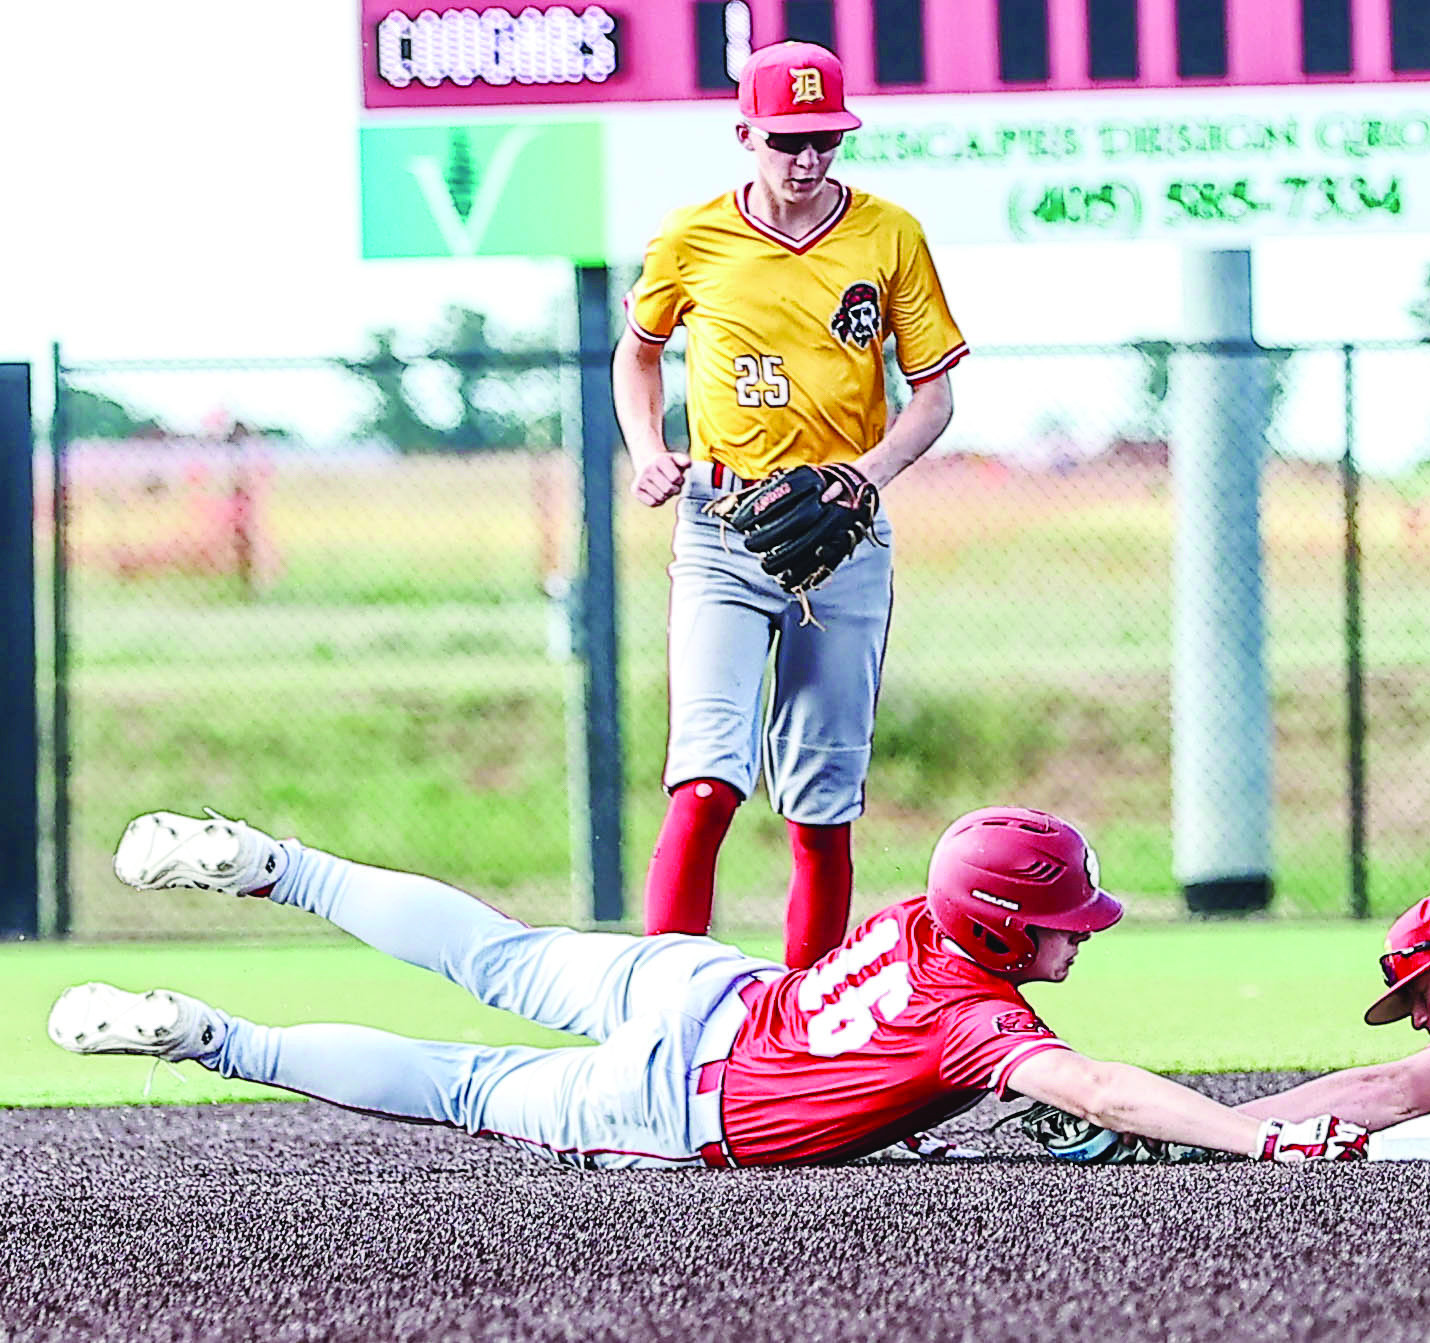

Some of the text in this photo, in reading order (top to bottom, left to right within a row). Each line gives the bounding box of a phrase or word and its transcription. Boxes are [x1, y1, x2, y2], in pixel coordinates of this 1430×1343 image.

[789, 67, 824, 104] D
[1099, 117, 1297, 157] DESIGN
[733, 354, 790, 408] 25
